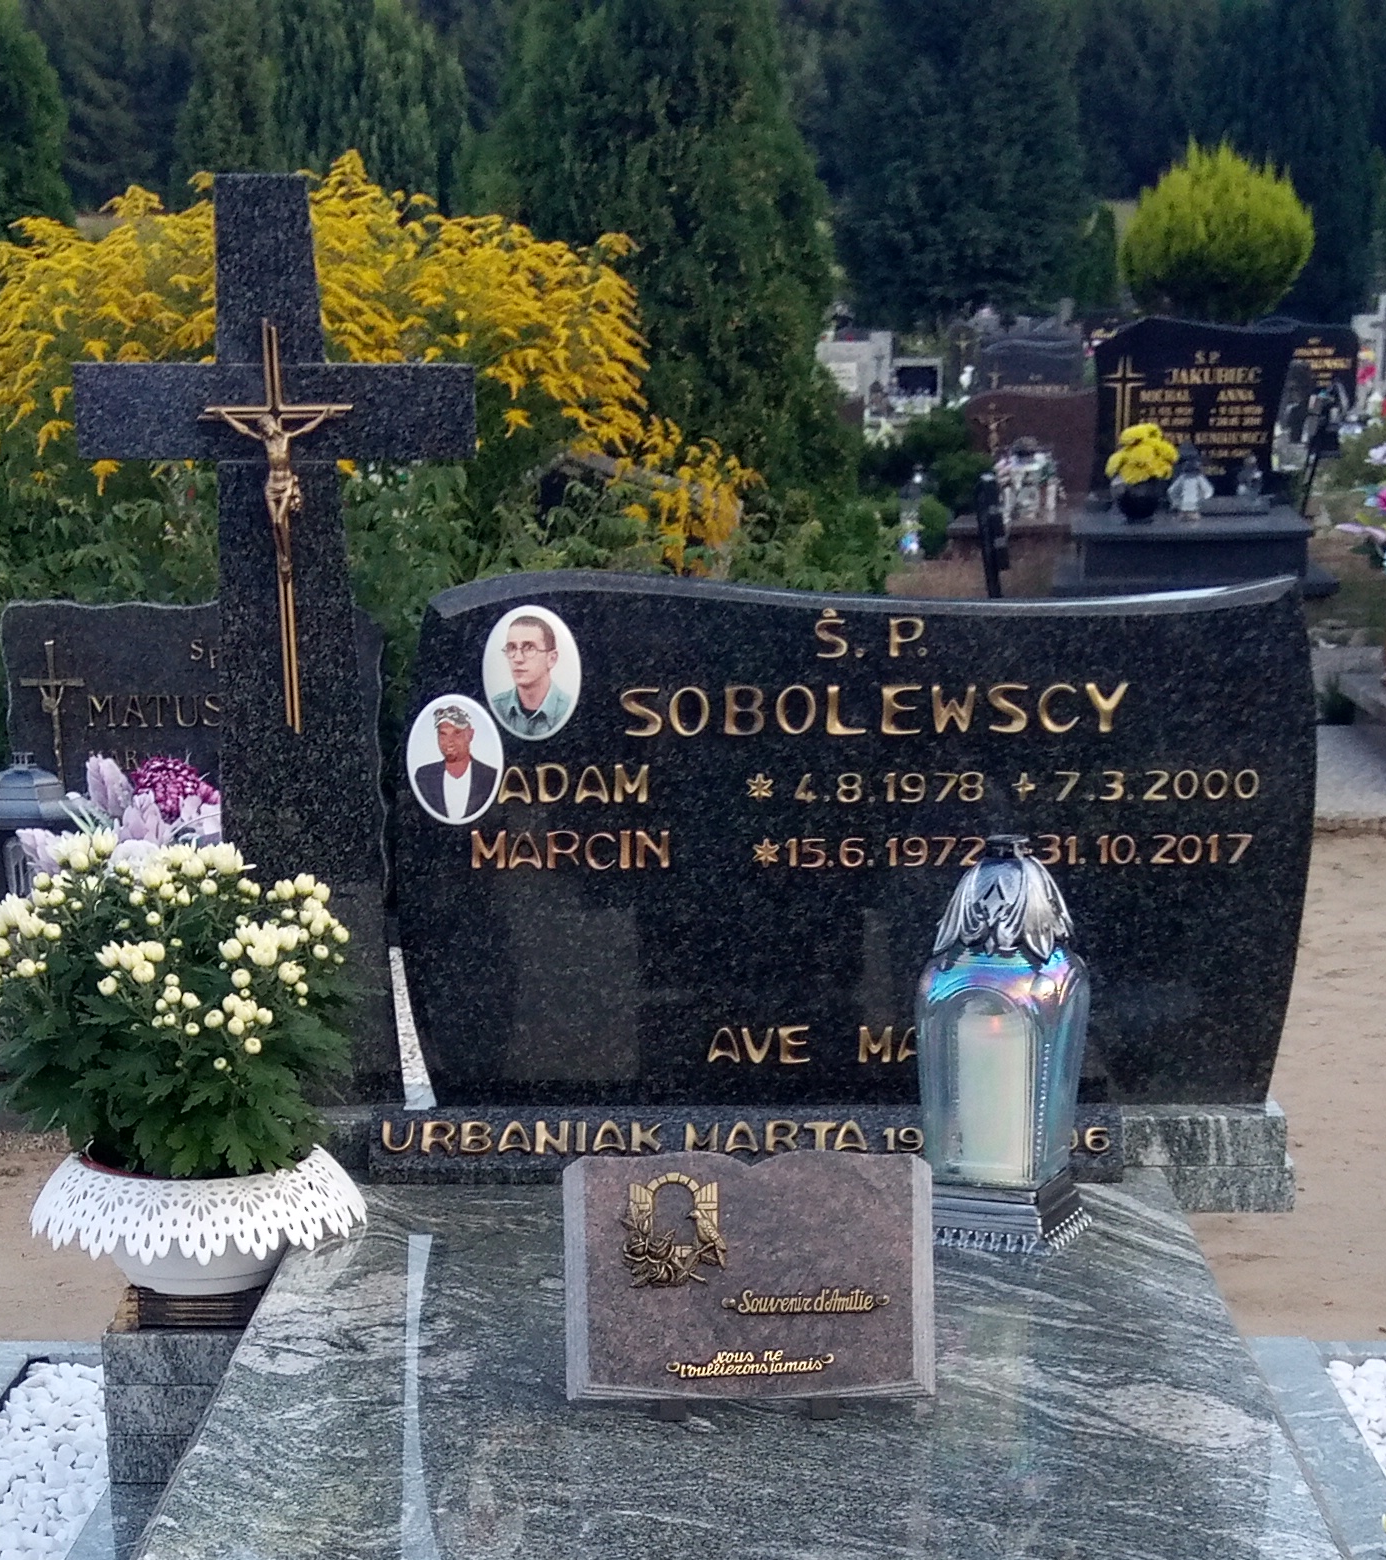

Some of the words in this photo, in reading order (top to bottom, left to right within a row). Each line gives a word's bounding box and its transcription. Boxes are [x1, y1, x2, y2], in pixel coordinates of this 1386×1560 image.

[619, 681, 1130, 738] SOBOLEWSCY
[497, 762, 650, 804] ADAM
[1054, 768, 1260, 802] 7.3.2000
[470, 829, 671, 870] MARCIN
[1037, 832, 1254, 866] 31.10.2017
[707, 1024, 811, 1065] AVE
[381, 1119, 663, 1155] URBANIAK
[684, 1119, 869, 1153] MARTA
[736, 1289, 813, 1314] Souvenir
[763, 1349, 784, 1362] ne
[769, 1357, 824, 1376] jamais
